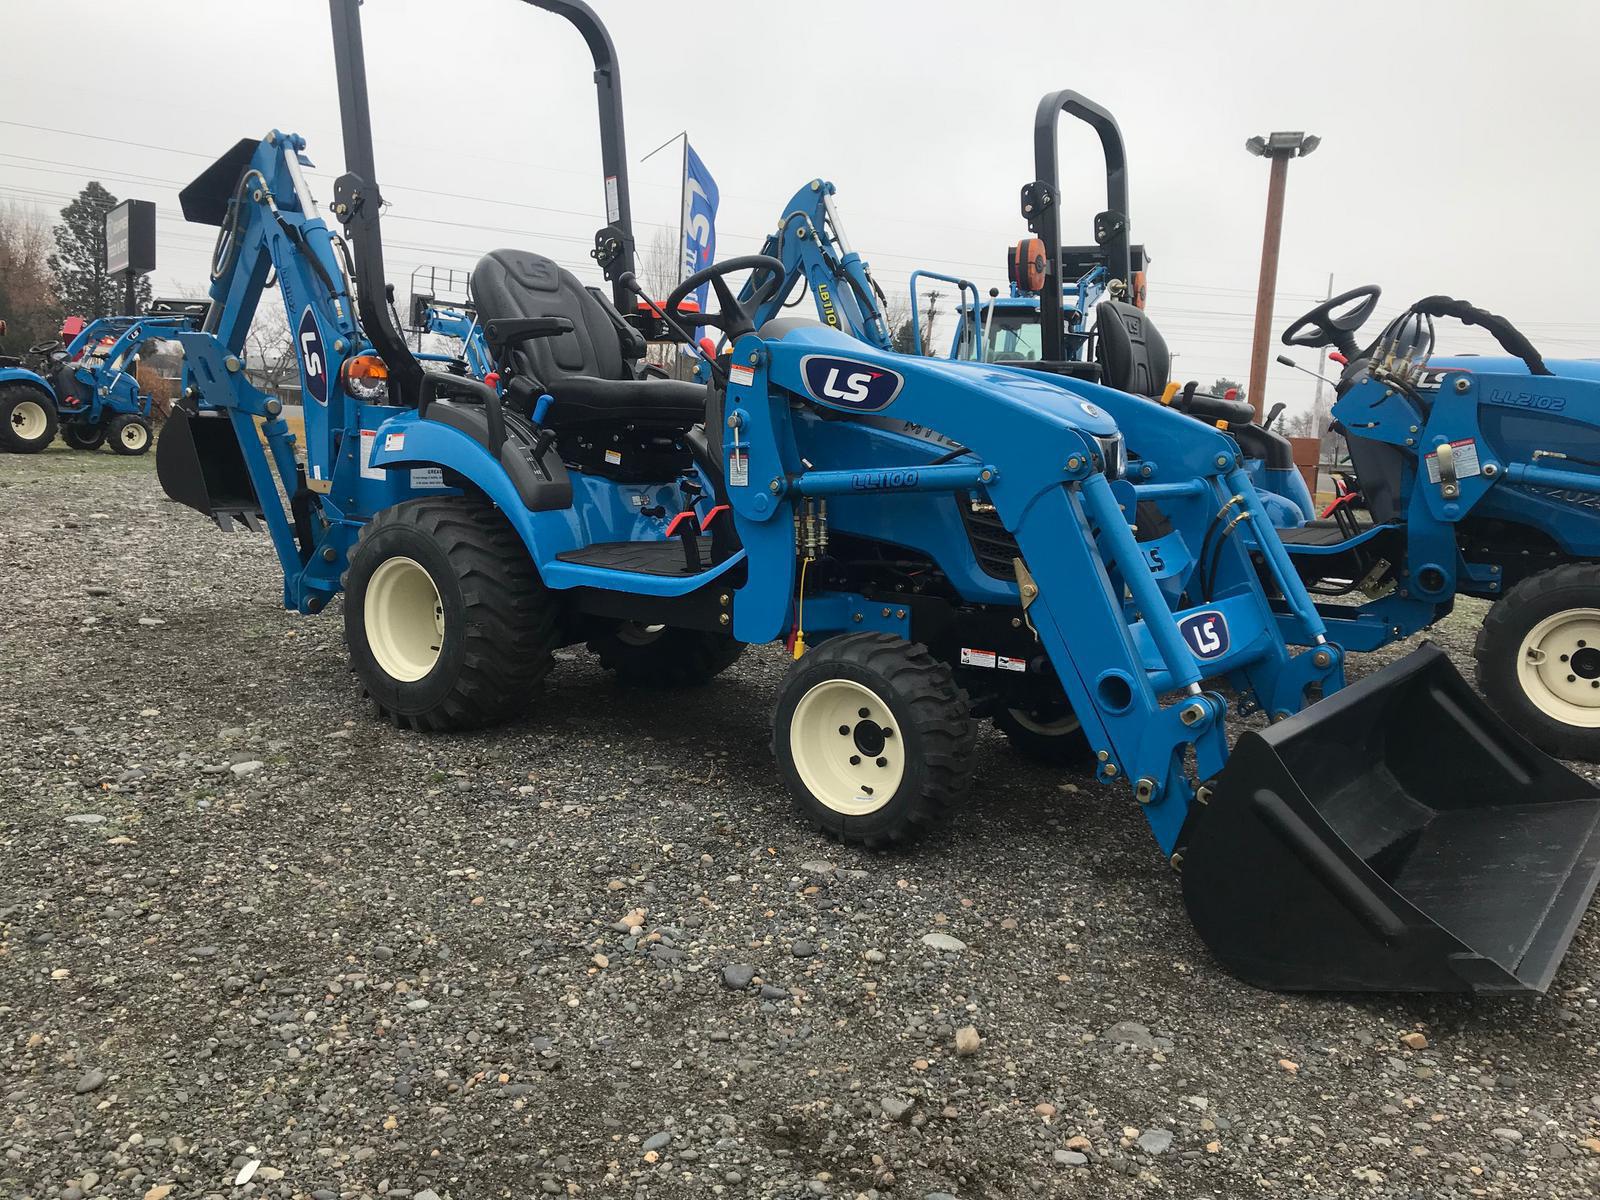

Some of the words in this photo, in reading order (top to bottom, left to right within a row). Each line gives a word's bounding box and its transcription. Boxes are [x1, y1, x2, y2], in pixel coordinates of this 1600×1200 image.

[687, 177, 710, 248] LS
[818, 284, 838, 327] LB110
[301, 332, 322, 377] LS
[823, 368, 872, 402] LS
[1490, 389, 1567, 411] LL2102
[851, 471, 919, 490] LL1100
[1193, 621, 1220, 654] LS
